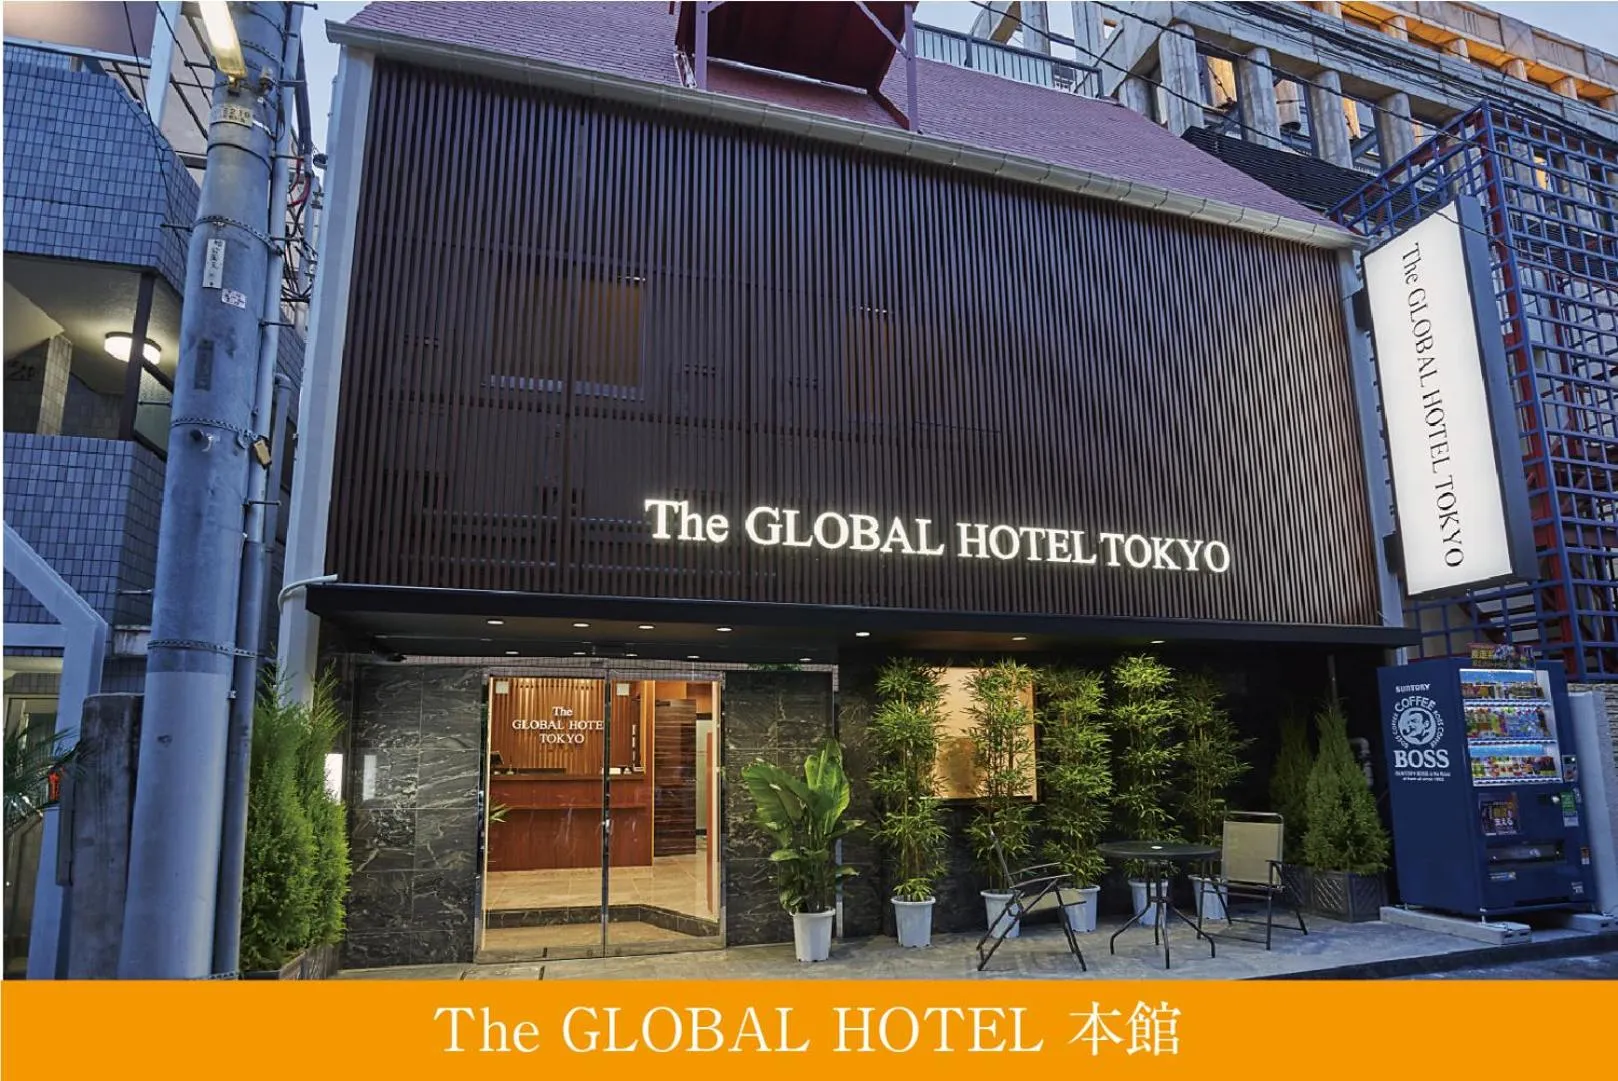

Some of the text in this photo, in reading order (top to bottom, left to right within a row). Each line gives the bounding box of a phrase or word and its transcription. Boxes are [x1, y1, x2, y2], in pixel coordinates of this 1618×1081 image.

[1402, 242, 1465, 569] The GLOBAL HOTEL TOKYO
[644, 498, 1231, 573] The GLOBAL HOTEL TOKYO
[552, 706, 573, 716] The
[1394, 696, 1437, 712] COFFEE
[512, 720, 604, 730] GLOBAL HOTE
[540, 733, 585, 744] TOKYO
[1393, 749, 1450, 768] BOSS
